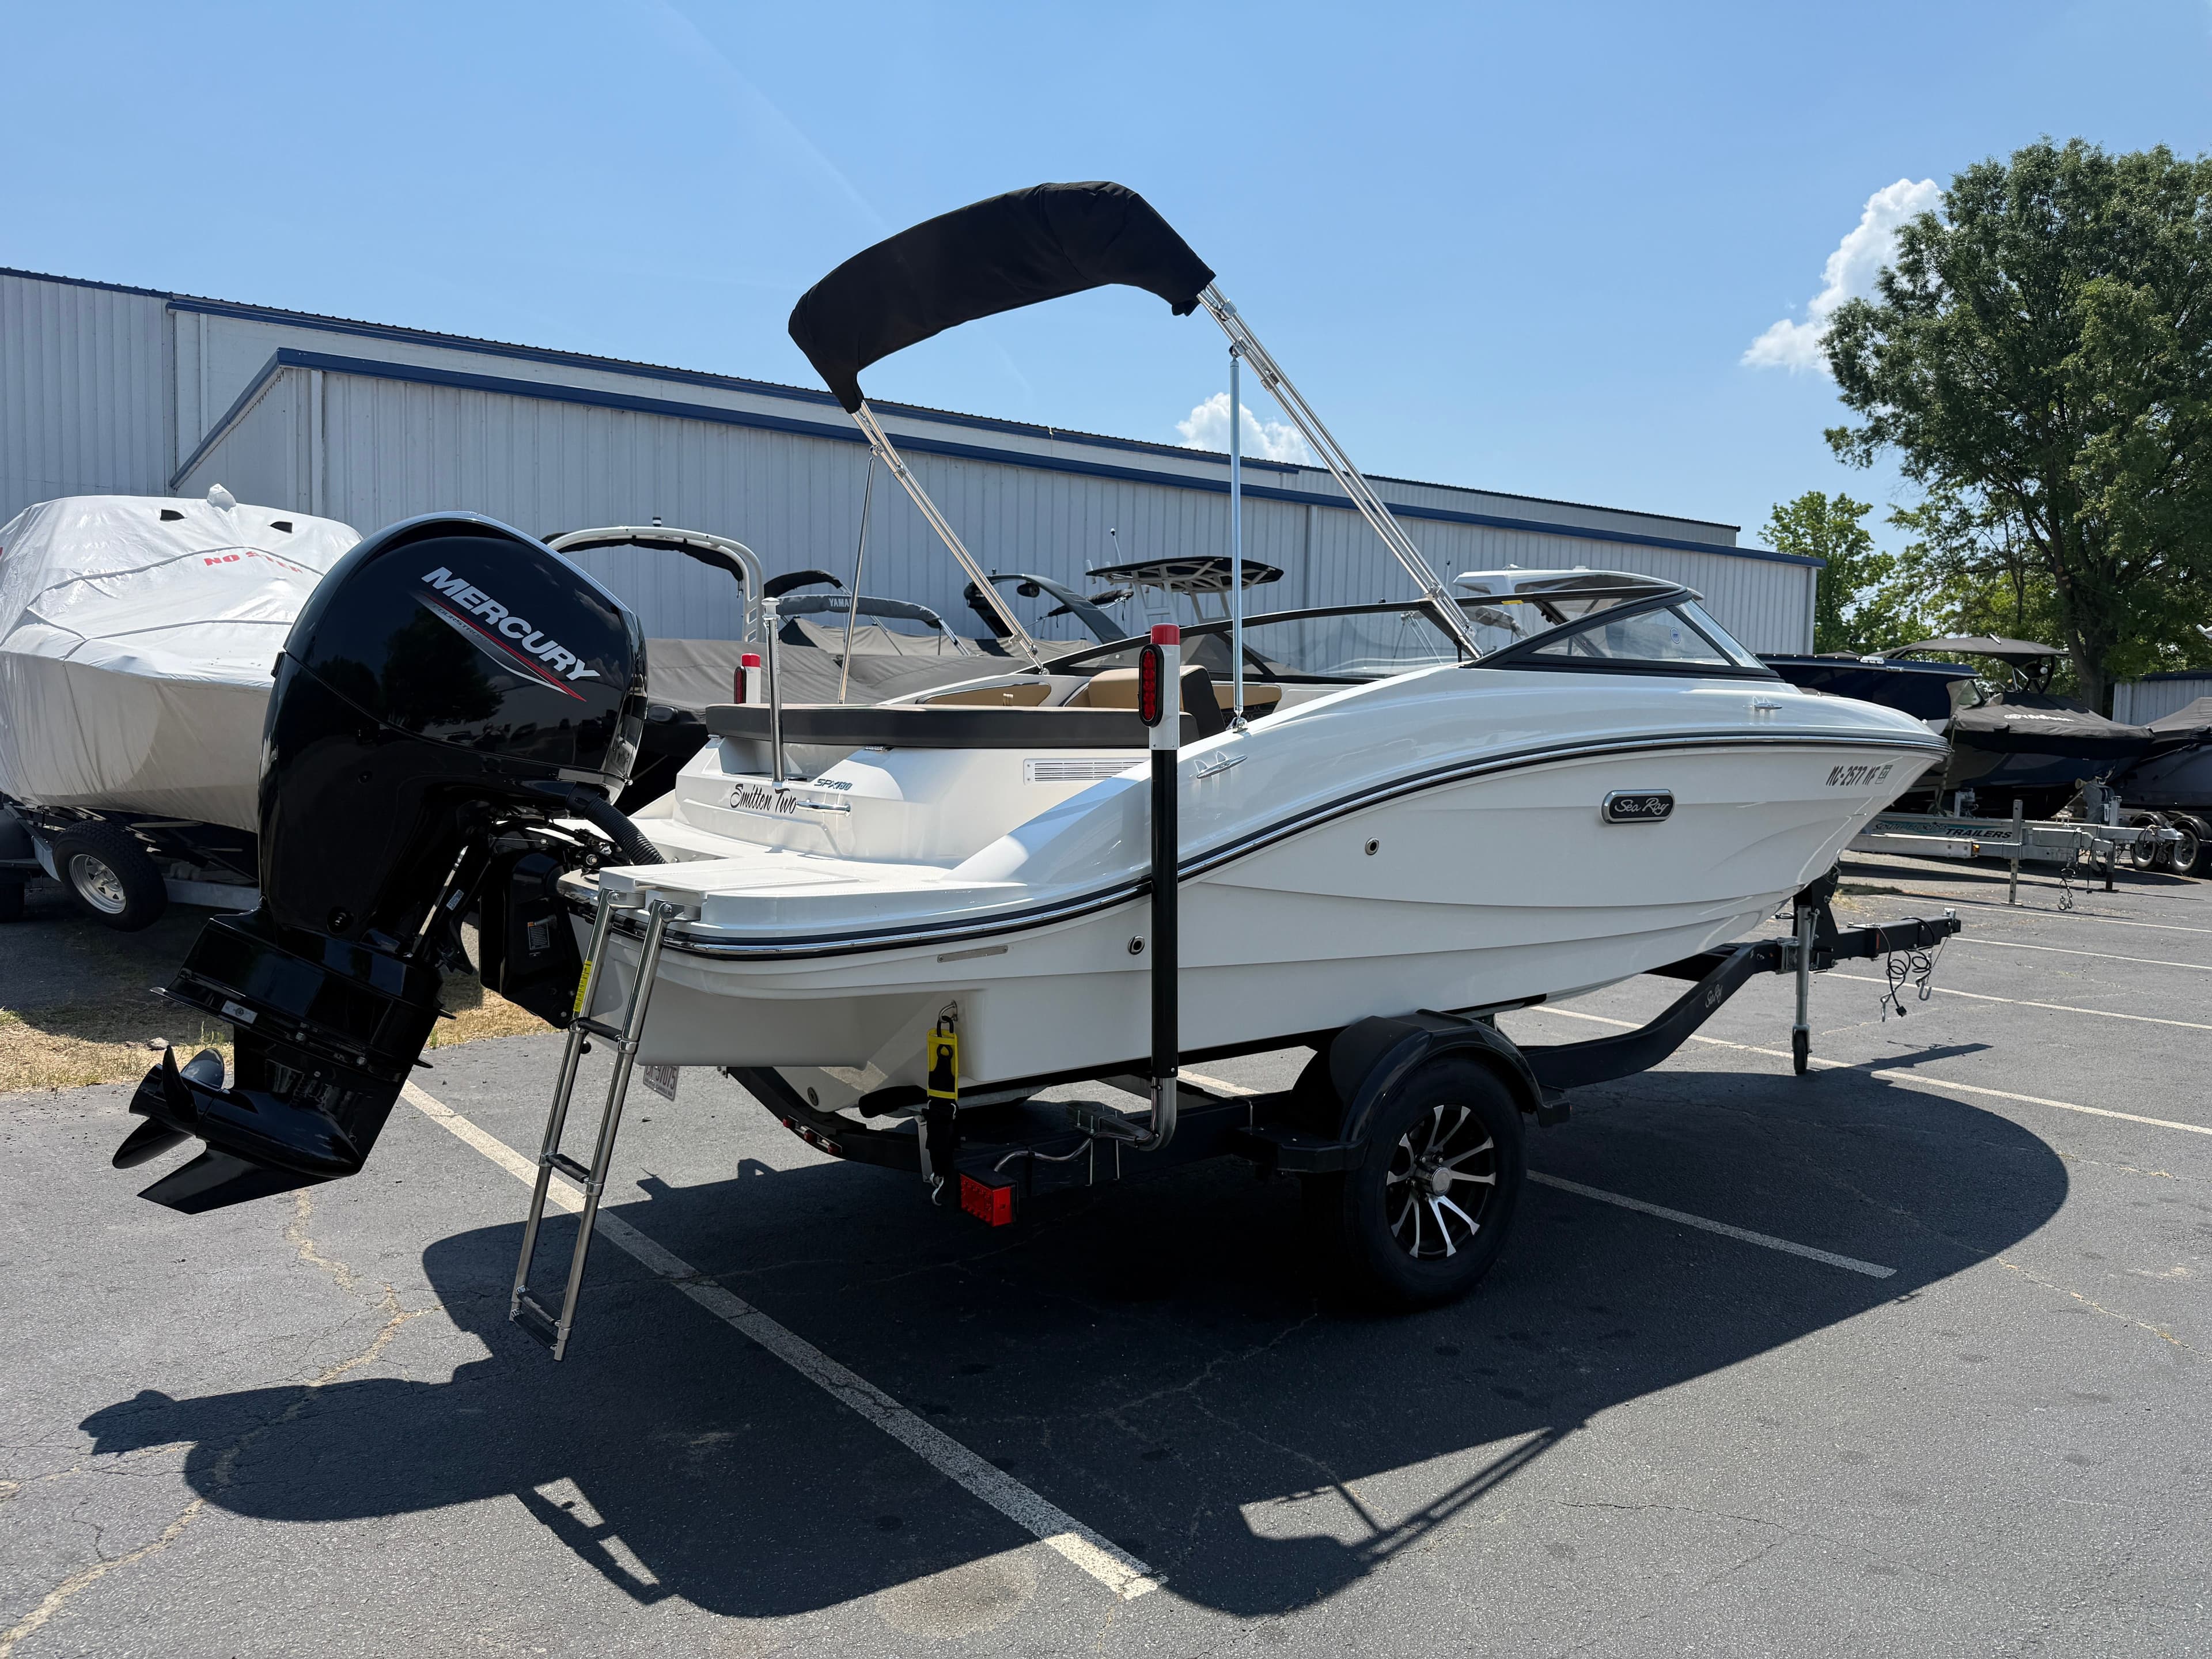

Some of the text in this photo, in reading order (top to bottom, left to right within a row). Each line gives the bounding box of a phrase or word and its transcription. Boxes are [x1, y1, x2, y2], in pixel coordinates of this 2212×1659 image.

[204, 554, 240, 566] NO
[828, 598, 858, 608] YAMA
[421, 567, 600, 681] MERCURY
[730, 783, 797, 814] Smitten Two
[1615, 798, 1669, 815] Sea Ray
[1945, 828, 2013, 838] TRAILERS
